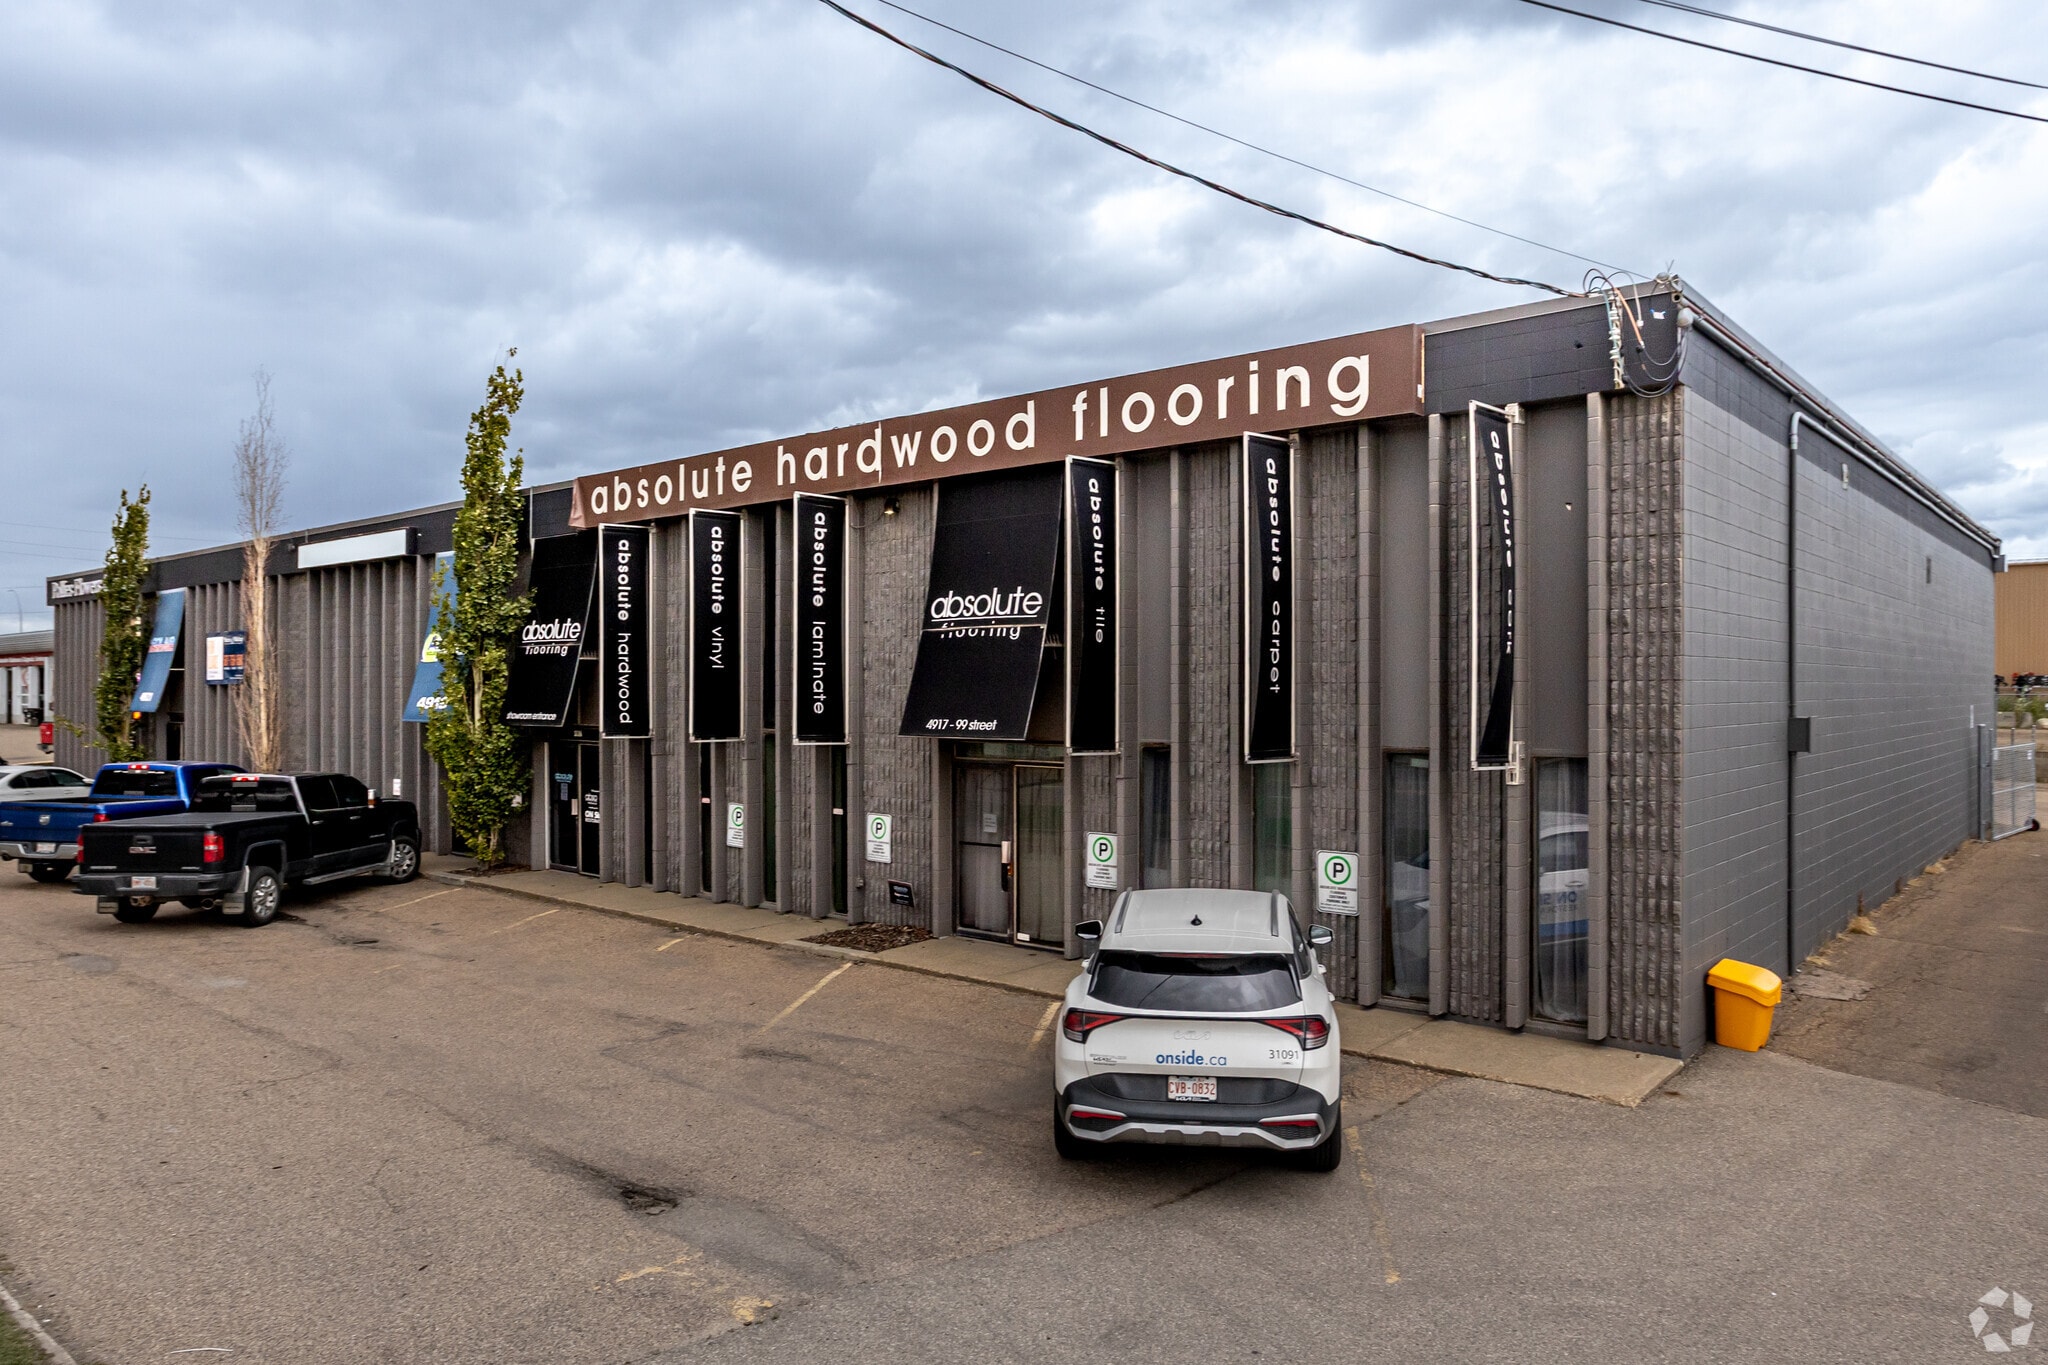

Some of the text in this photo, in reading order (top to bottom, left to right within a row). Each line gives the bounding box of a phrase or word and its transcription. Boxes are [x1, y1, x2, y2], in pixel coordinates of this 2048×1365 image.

[590, 354, 1370, 515] absolute hardwood flooring
[1088, 477, 1106, 644] absolute tile
[1265, 457, 1283, 695] absolute carpet
[709, 526, 726, 669] absolute vinyl
[931, 585, 1043, 619] absolute
[812, 511, 829, 715] absolute laminate
[522, 618, 581, 641] absolute
[617, 539, 633, 724] absolute hardwood
[925, 718, 949, 730] 4917
[955, 718, 968, 730] 99
[968, 719, 998, 731] street
[875, 822, 883, 834] P
[1098, 842, 1109, 856] P
[1333, 862, 1344, 878] P
[1155, 1050, 1227, 1066] onside.ca
[1269, 1050, 1300, 1060] 31091
[1168, 1081, 1216, 1096] CVB-0832
